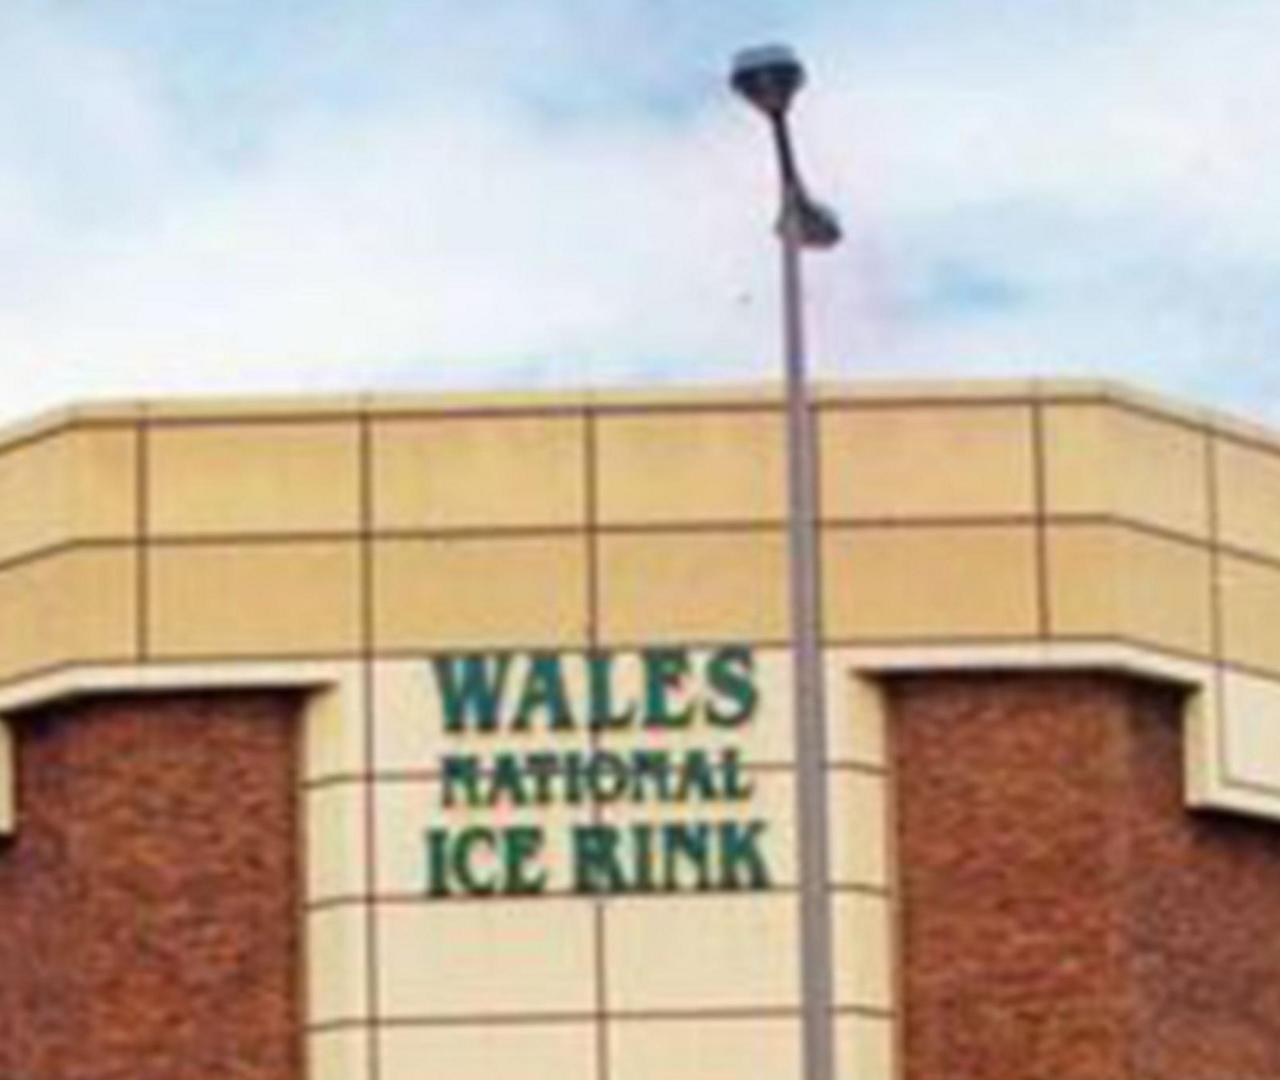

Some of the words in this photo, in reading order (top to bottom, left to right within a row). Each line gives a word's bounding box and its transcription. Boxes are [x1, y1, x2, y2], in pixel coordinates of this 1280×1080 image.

[429, 645, 760, 733] WALES
[438, 749, 753, 807] NATIONAL
[424, 826, 546, 898] ICE
[569, 819, 772, 893] RINK
